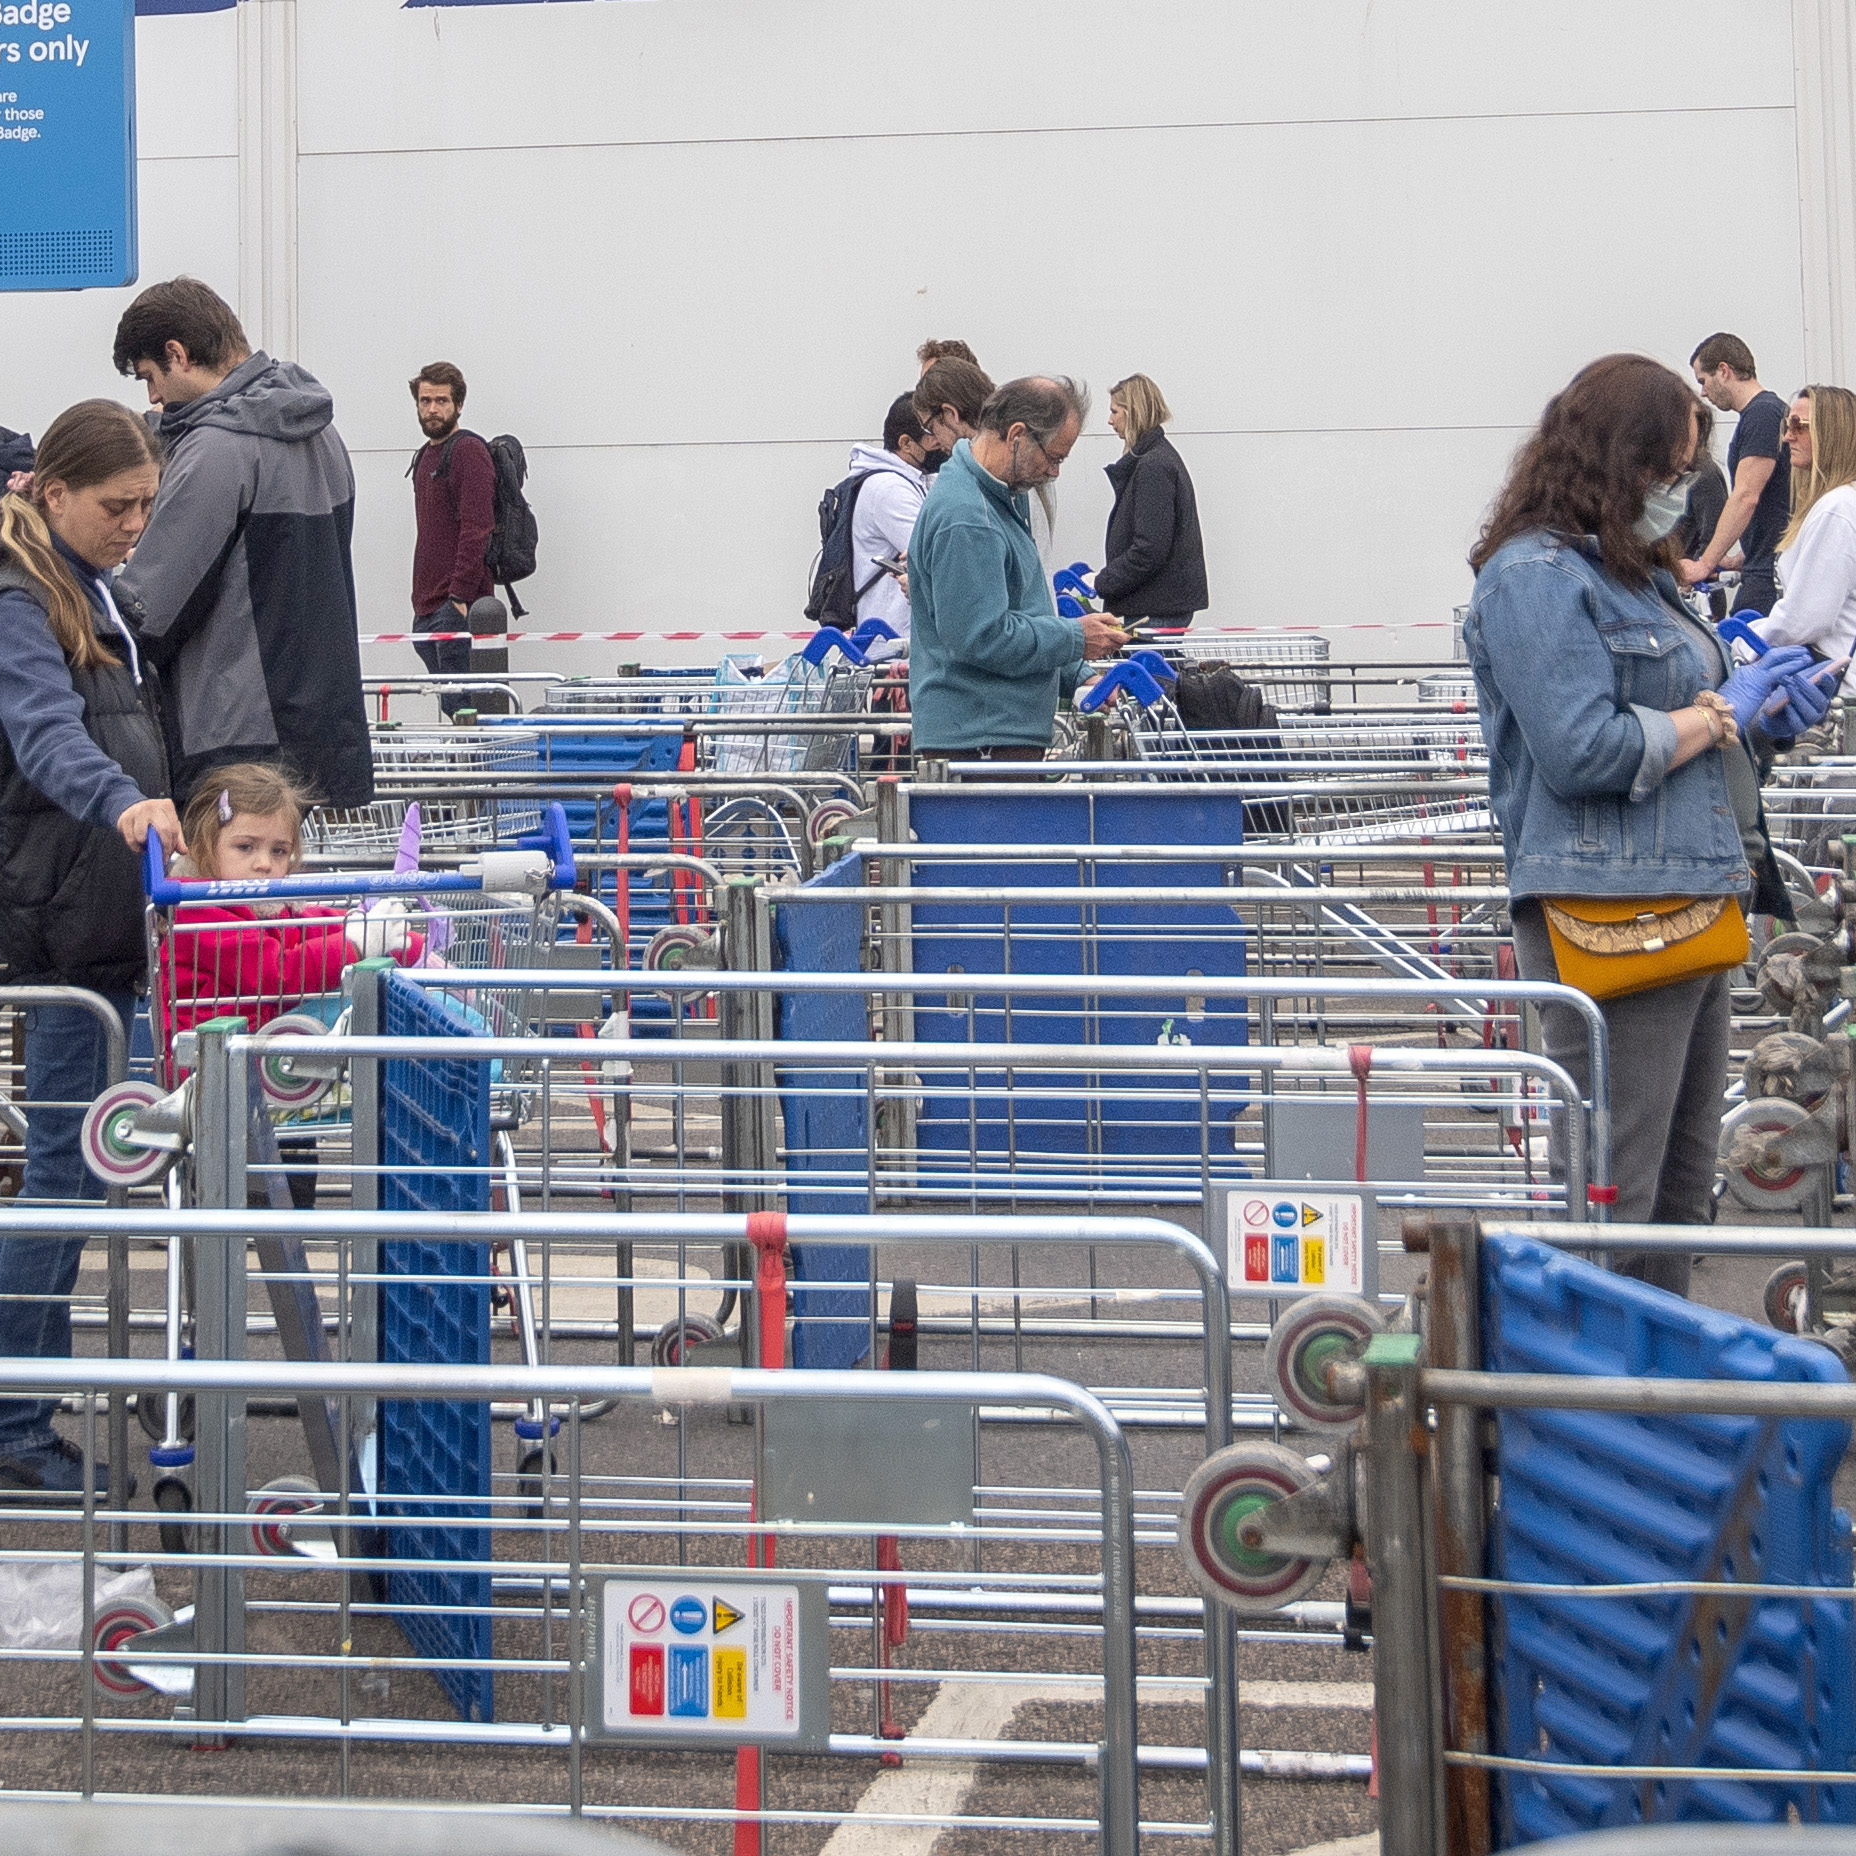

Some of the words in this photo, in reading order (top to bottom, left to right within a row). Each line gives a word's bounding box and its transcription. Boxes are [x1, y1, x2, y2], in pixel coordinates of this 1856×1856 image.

[28, 33, 90, 67] only
[4, 106, 45, 121] those
[773, 1626, 781, 1638] DO
[785, 1598, 793, 1650] IMPORTANT
[773, 1641, 781, 1659] NOT
[773, 1662, 782, 1691] COVER
[785, 1653, 794, 1685] SAFETY
[786, 1688, 794, 1721] NOTICE
